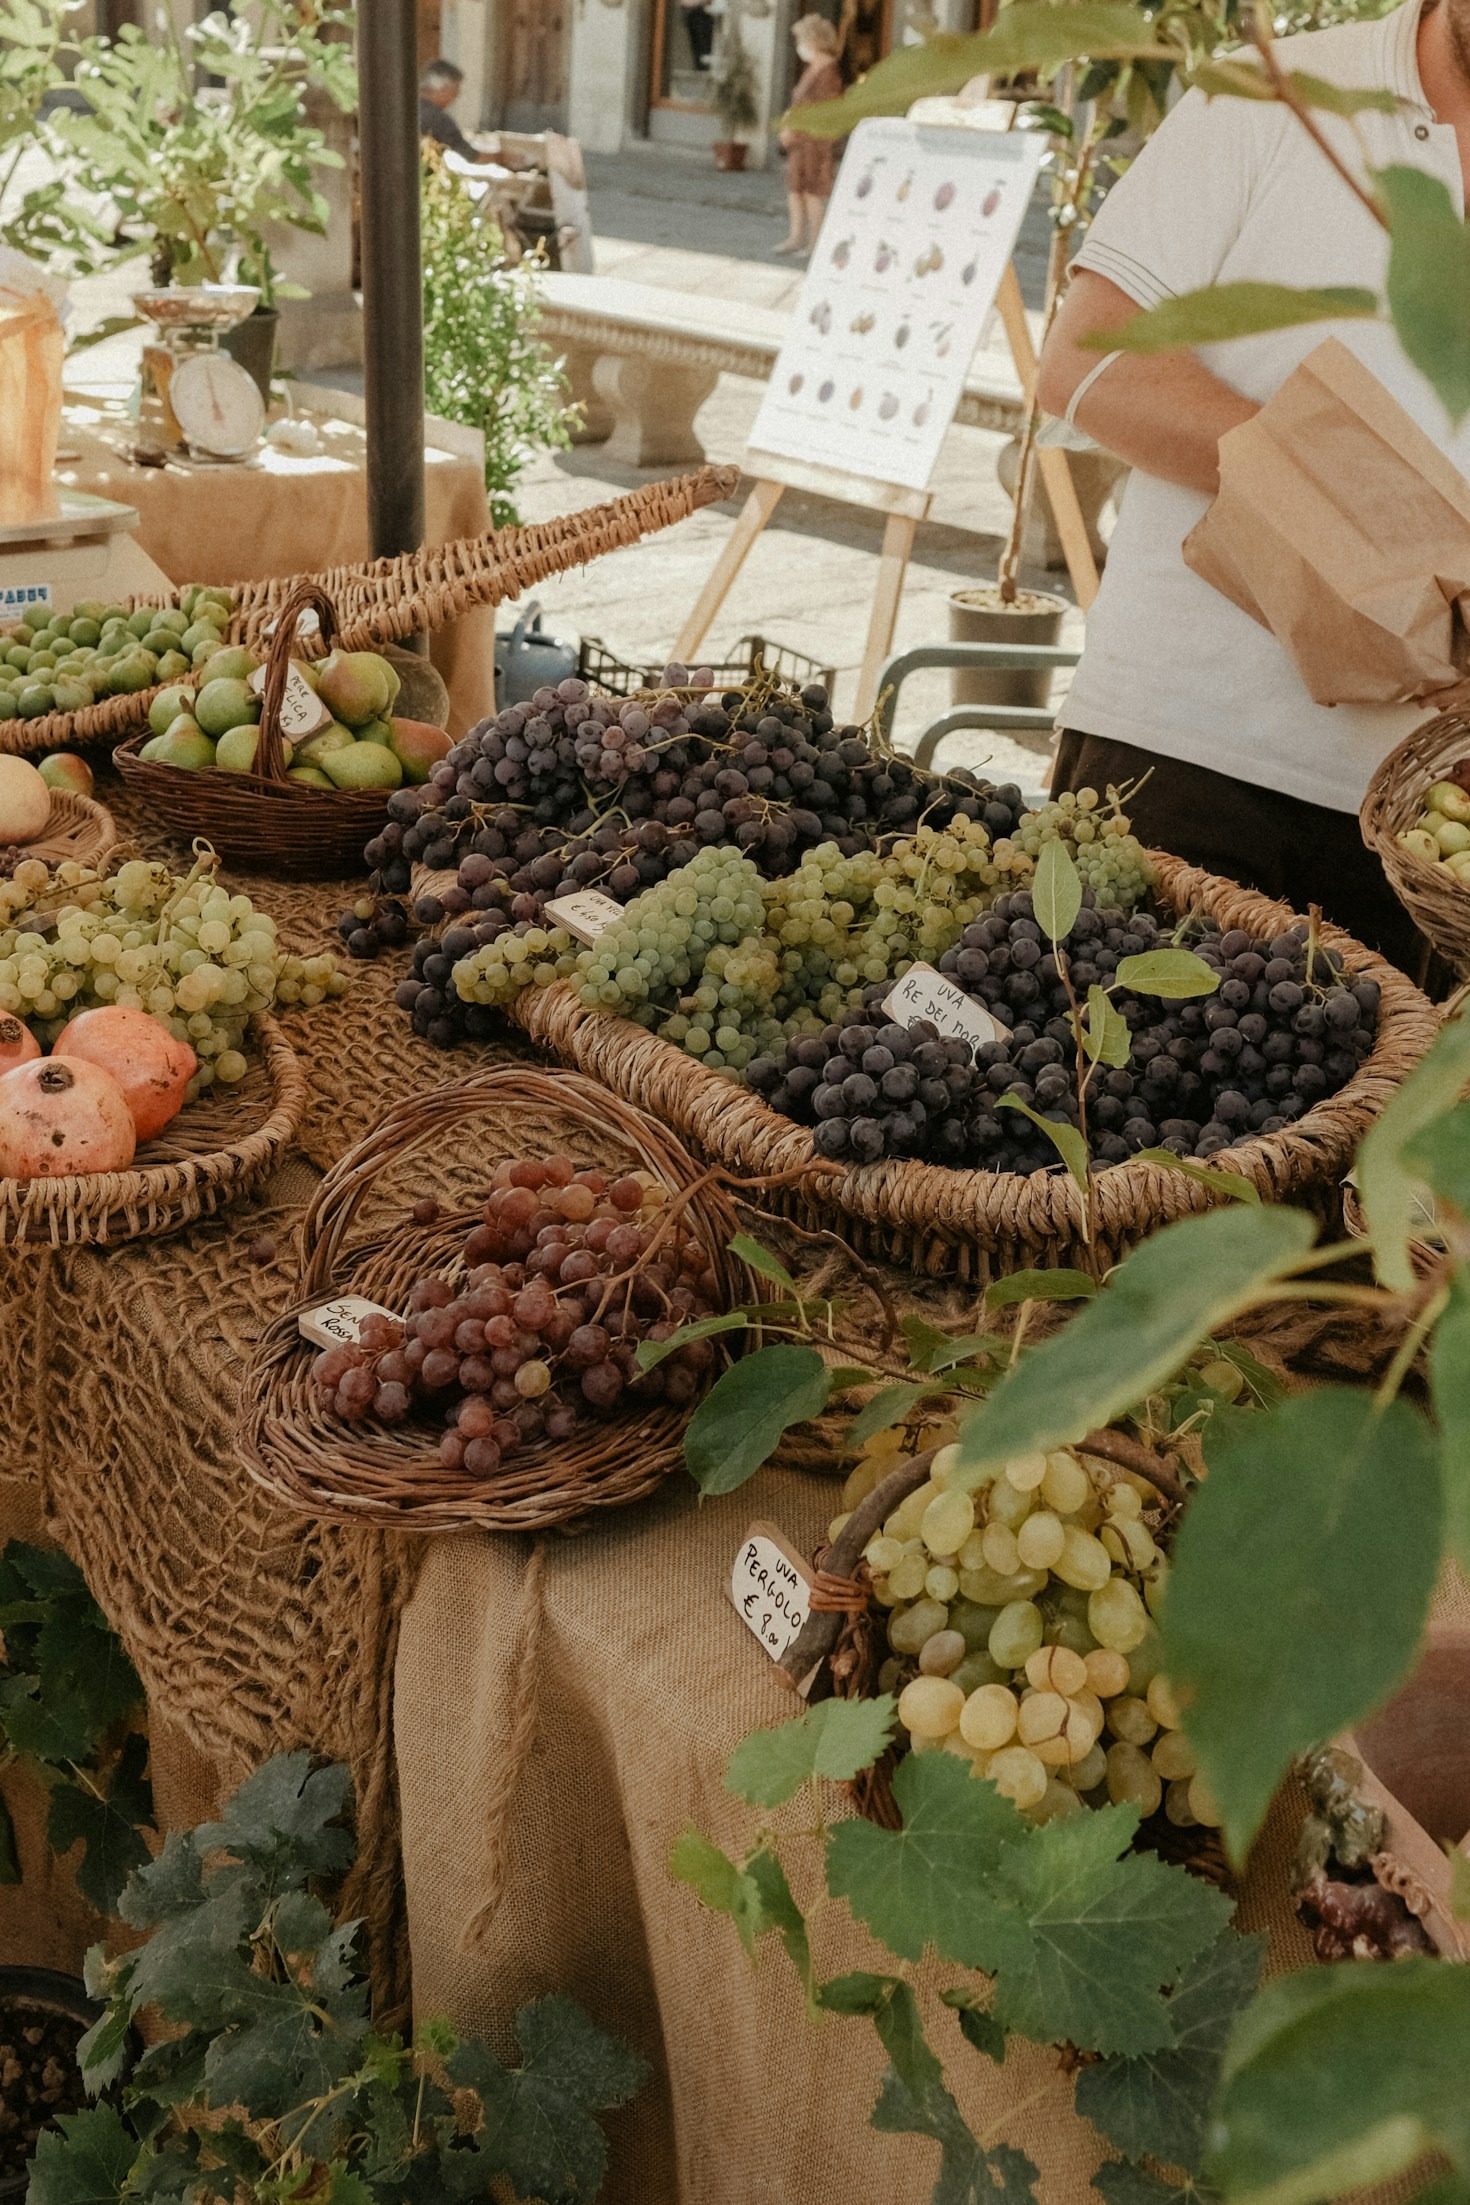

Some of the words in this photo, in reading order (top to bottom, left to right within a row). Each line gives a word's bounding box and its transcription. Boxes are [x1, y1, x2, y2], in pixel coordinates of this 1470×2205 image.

[290, 675, 310, 698] PERE
[902, 979, 923, 1004] RE
[925, 1000, 948, 1023] DEI
[937, 984, 966, 1010] UVA
[326, 1304, 361, 1325] SEN
[775, 1558, 798, 1590] UVA
[743, 1594, 760, 1619] €
